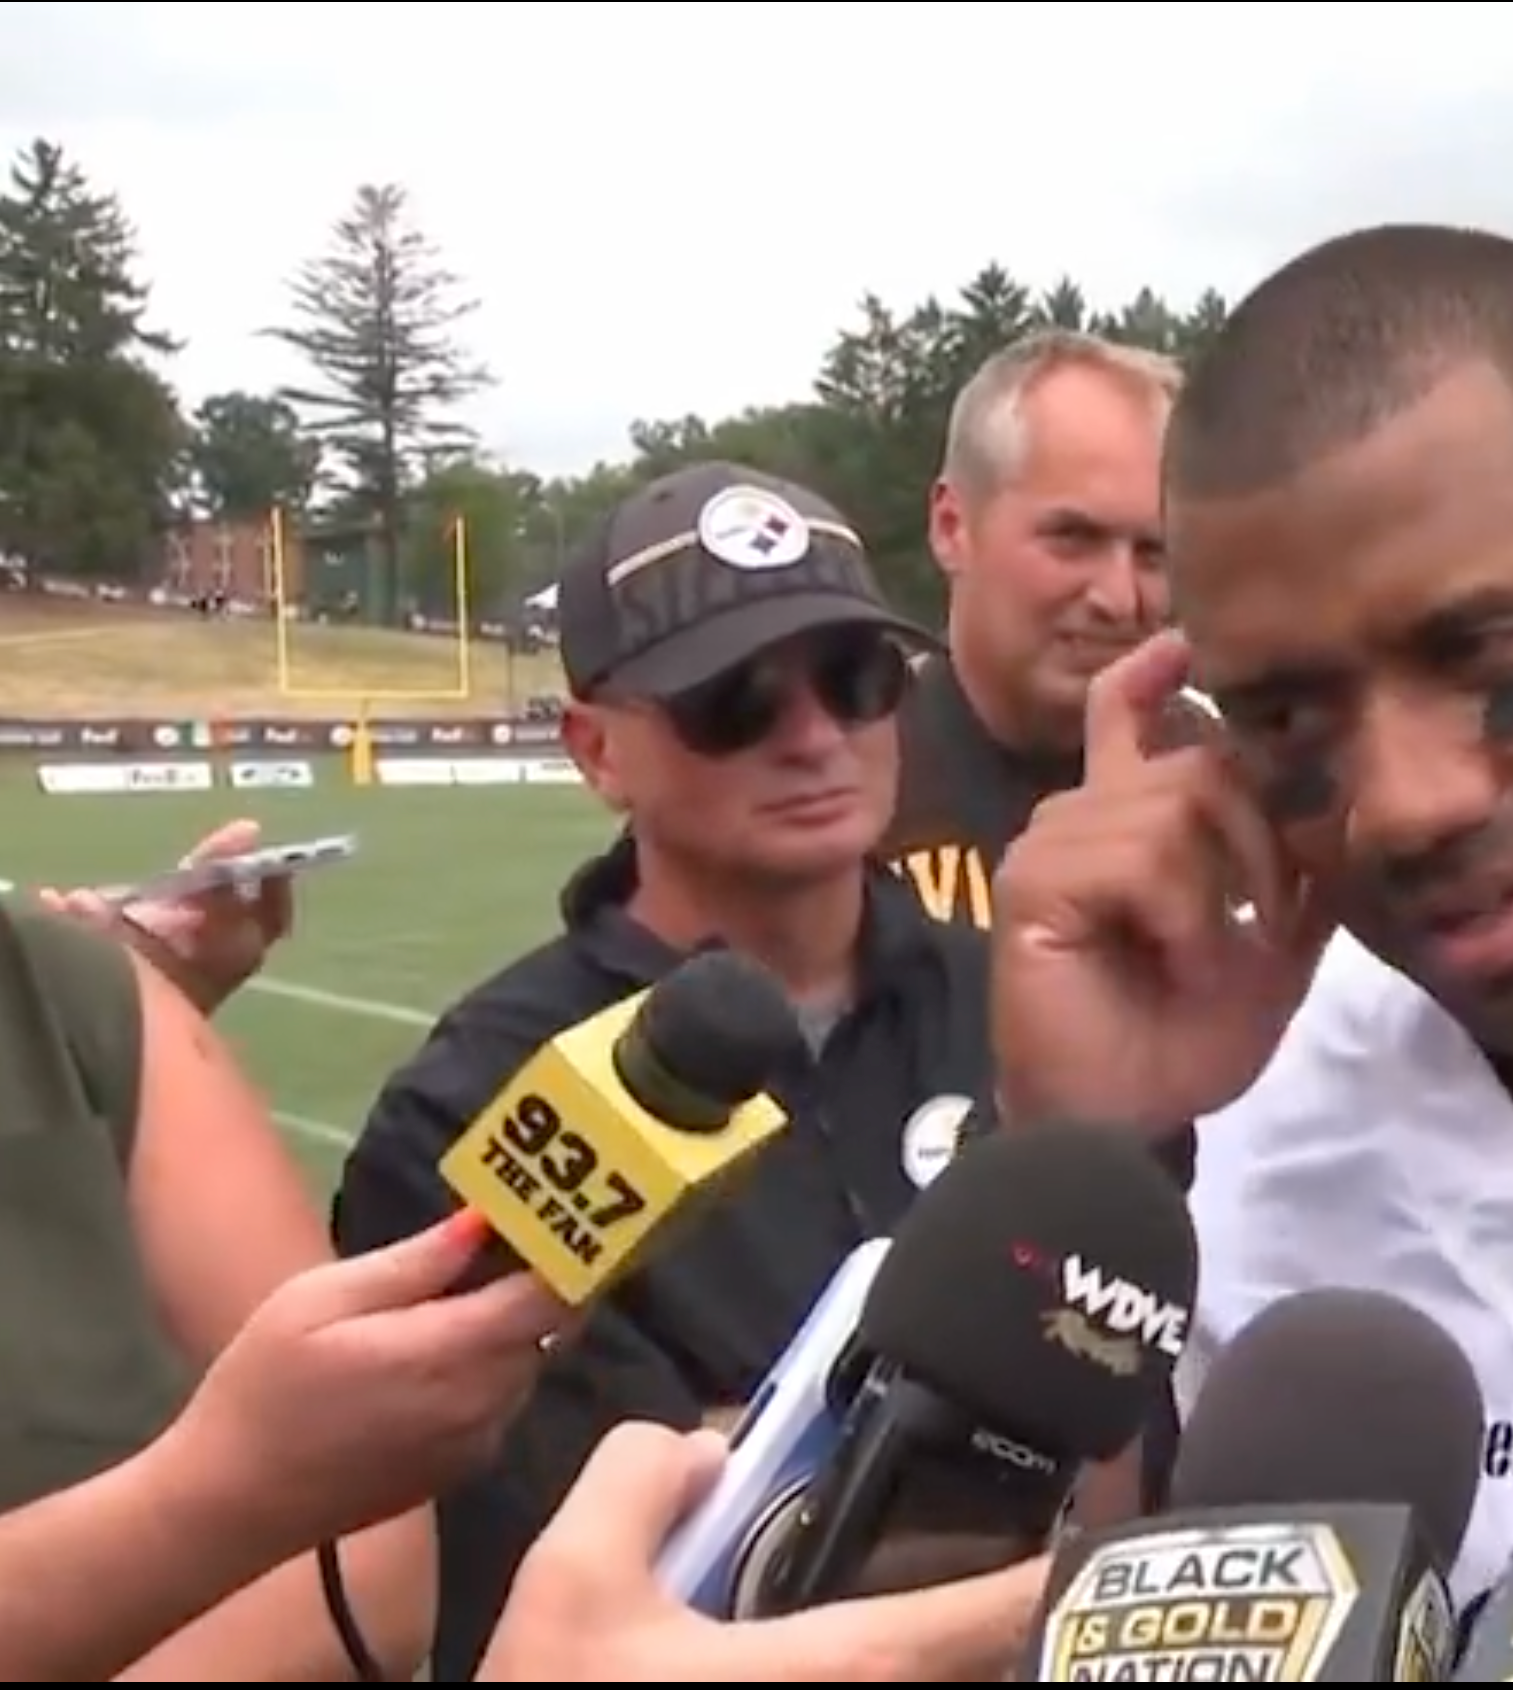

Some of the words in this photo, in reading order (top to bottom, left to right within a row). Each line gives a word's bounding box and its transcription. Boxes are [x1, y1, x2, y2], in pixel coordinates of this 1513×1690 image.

[480, 1136, 541, 1204] THE
[536, 1196, 603, 1267] FAN
[503, 1093, 646, 1229] 93.7
[1062, 1253, 1188, 1357] WDVE
[1094, 1547, 1306, 1602] BLACK
[1118, 1599, 1299, 1647] GOLD
